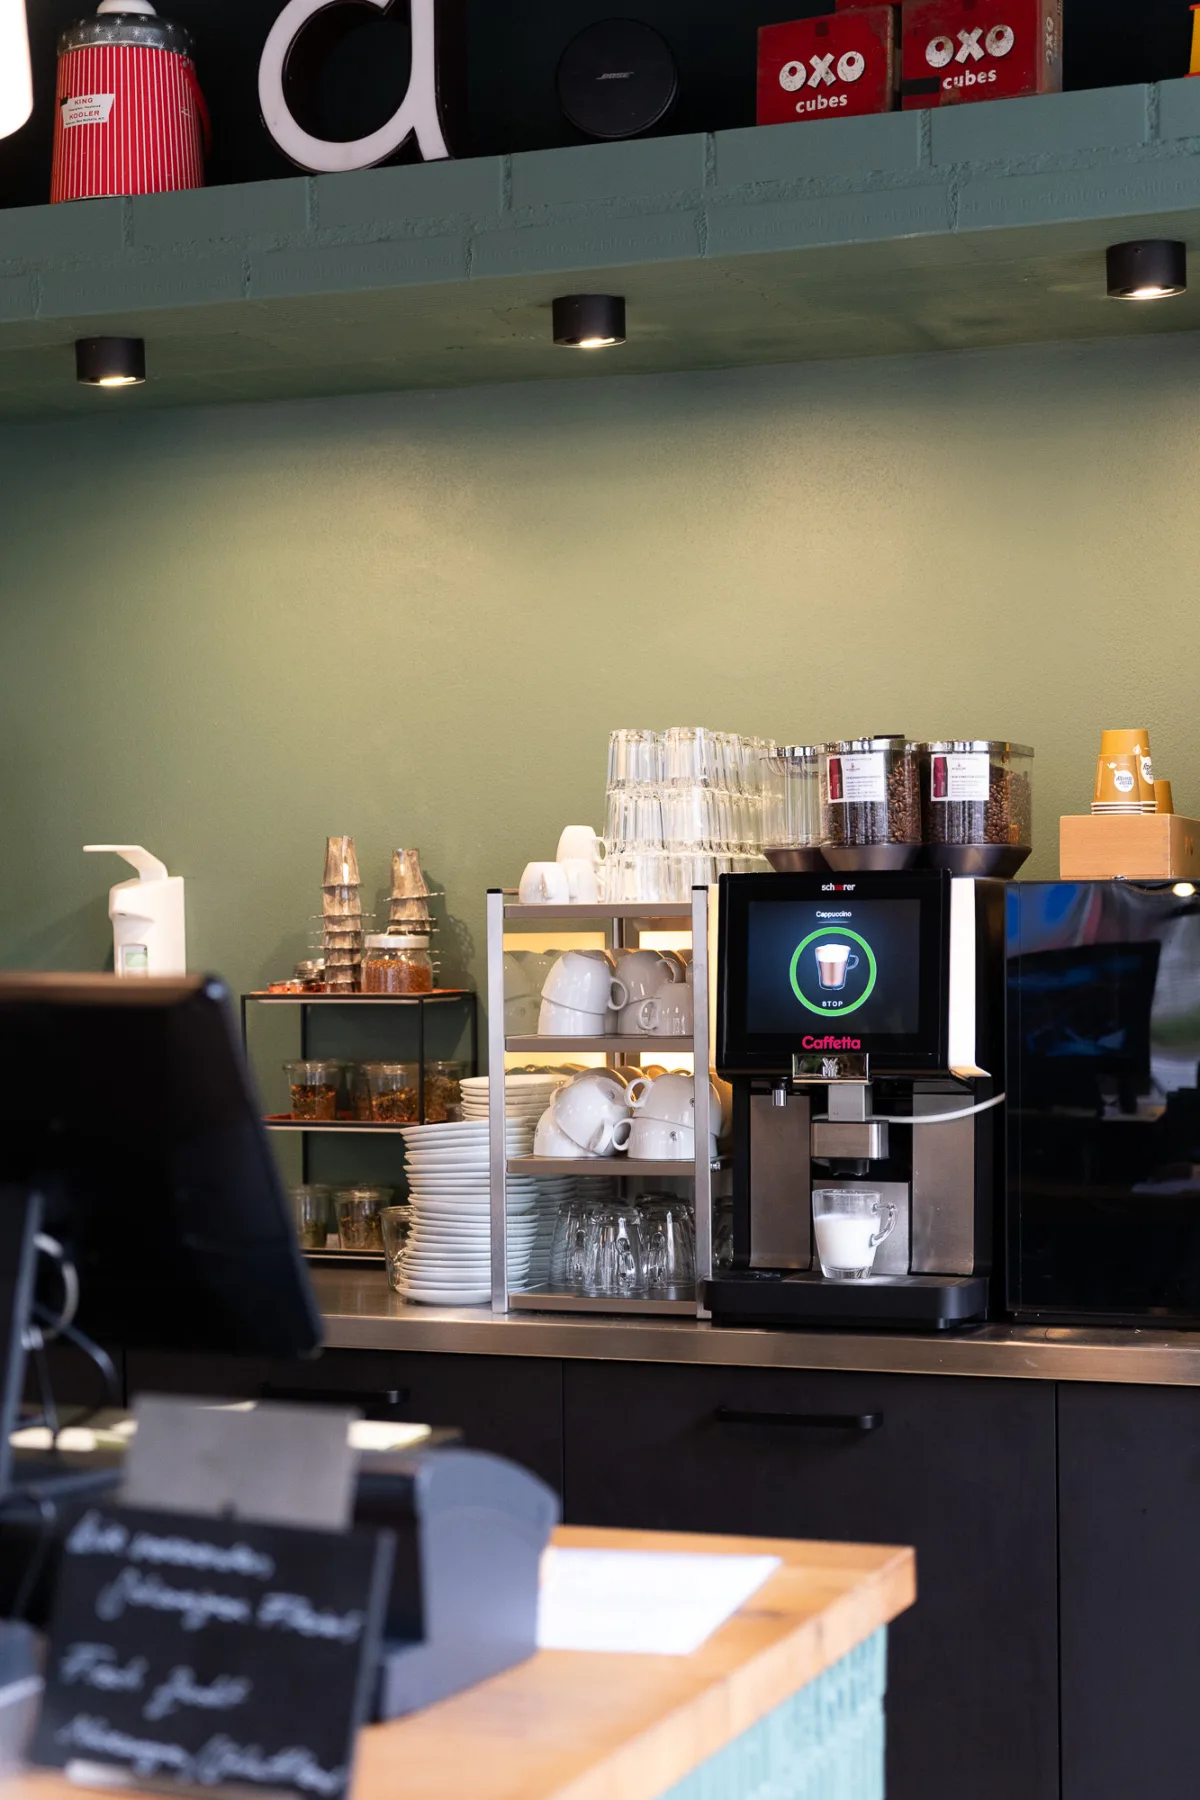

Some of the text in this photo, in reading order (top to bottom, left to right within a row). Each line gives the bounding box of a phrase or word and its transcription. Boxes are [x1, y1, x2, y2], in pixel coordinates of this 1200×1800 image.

[926, 24, 1015, 68] OXO
[779, 51, 865, 92] OXO
[942, 69, 997, 90] cubes
[74, 97, 93, 105] KING
[795, 94, 848, 113] cubes
[69, 110, 100, 119] KOOLER
[815, 910, 852, 918] Cappuccino
[801, 1035, 861, 1050] Caffetta
